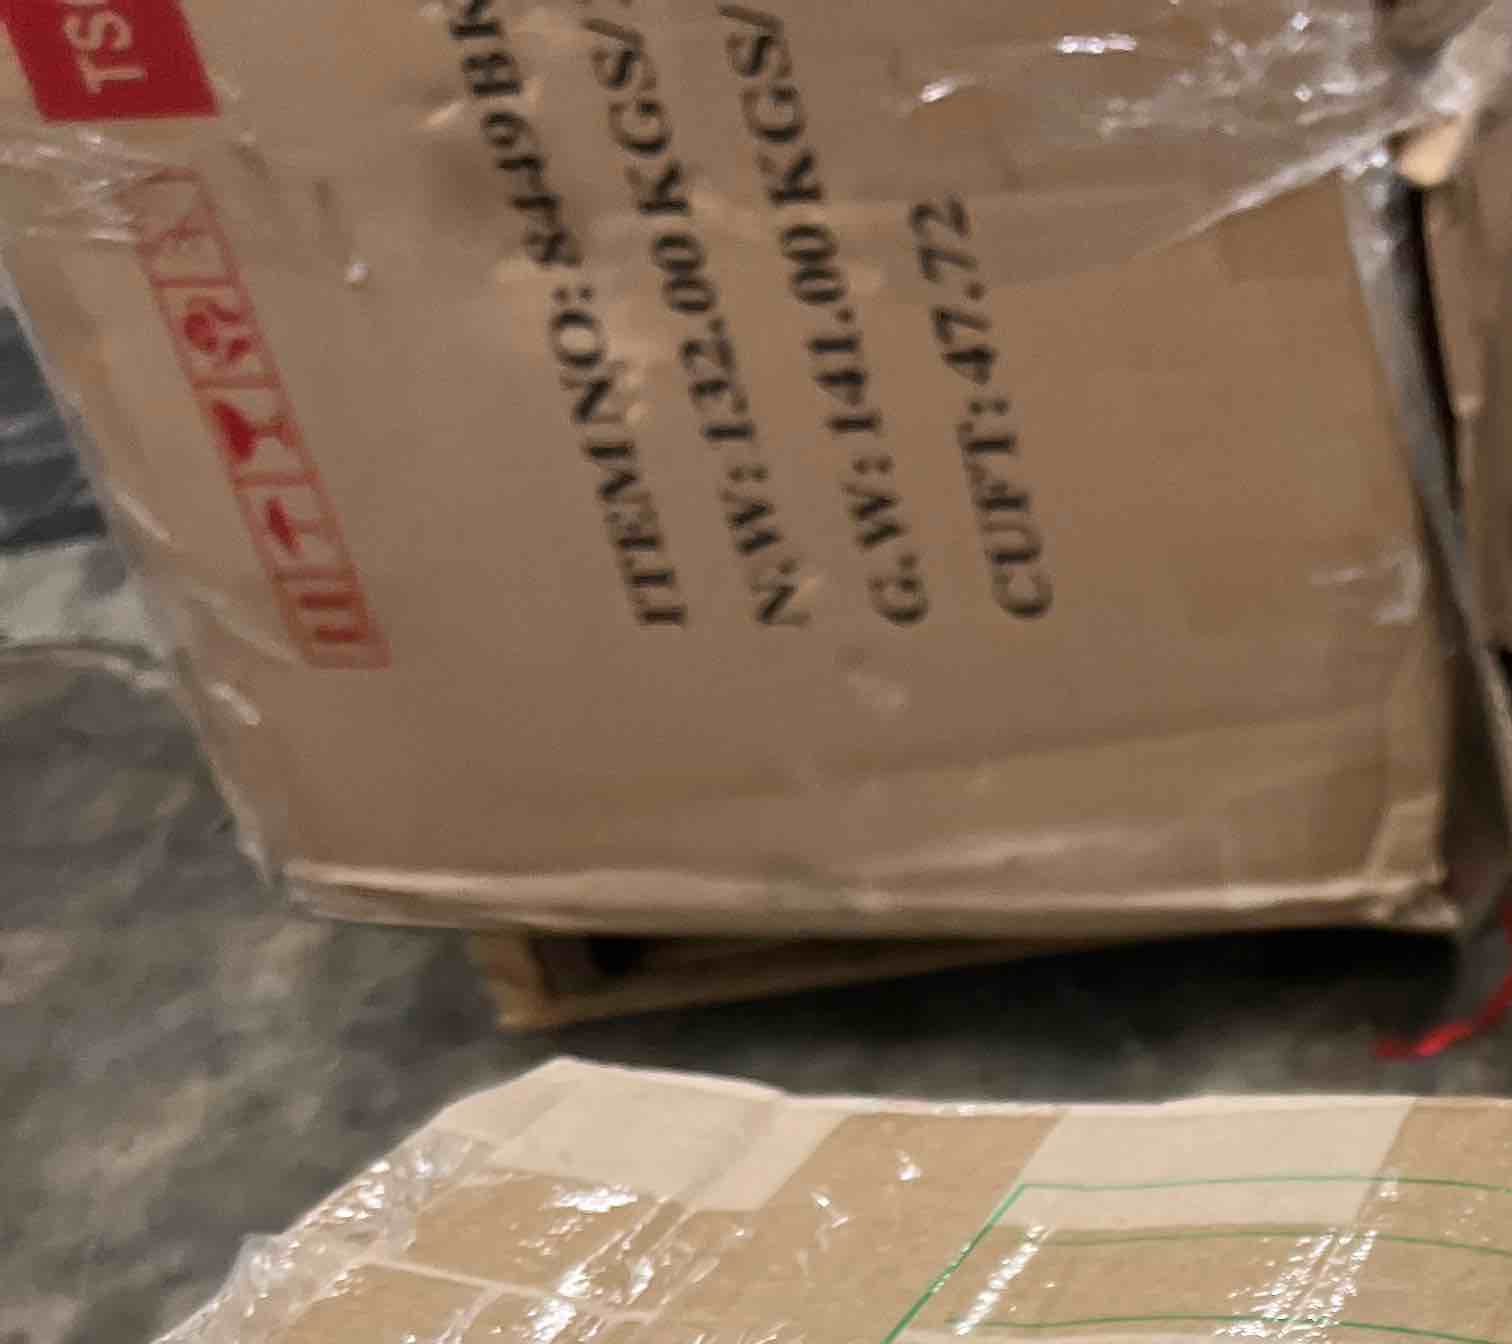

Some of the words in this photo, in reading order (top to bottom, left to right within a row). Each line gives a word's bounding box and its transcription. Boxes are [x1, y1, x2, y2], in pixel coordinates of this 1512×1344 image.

[62, 0, 147, 95] TS
[548, 284, 612, 426] NO:
[653, 229, 757, 444] 132.00
[778, 221, 882, 435] 141.00
[907, 195, 996, 385] 47.72
[581, 434, 690, 629] ITEM
[722, 462, 811, 630] N.W:
[841, 453, 930, 626] G.W:
[956, 395, 1055, 620] CUFT:
